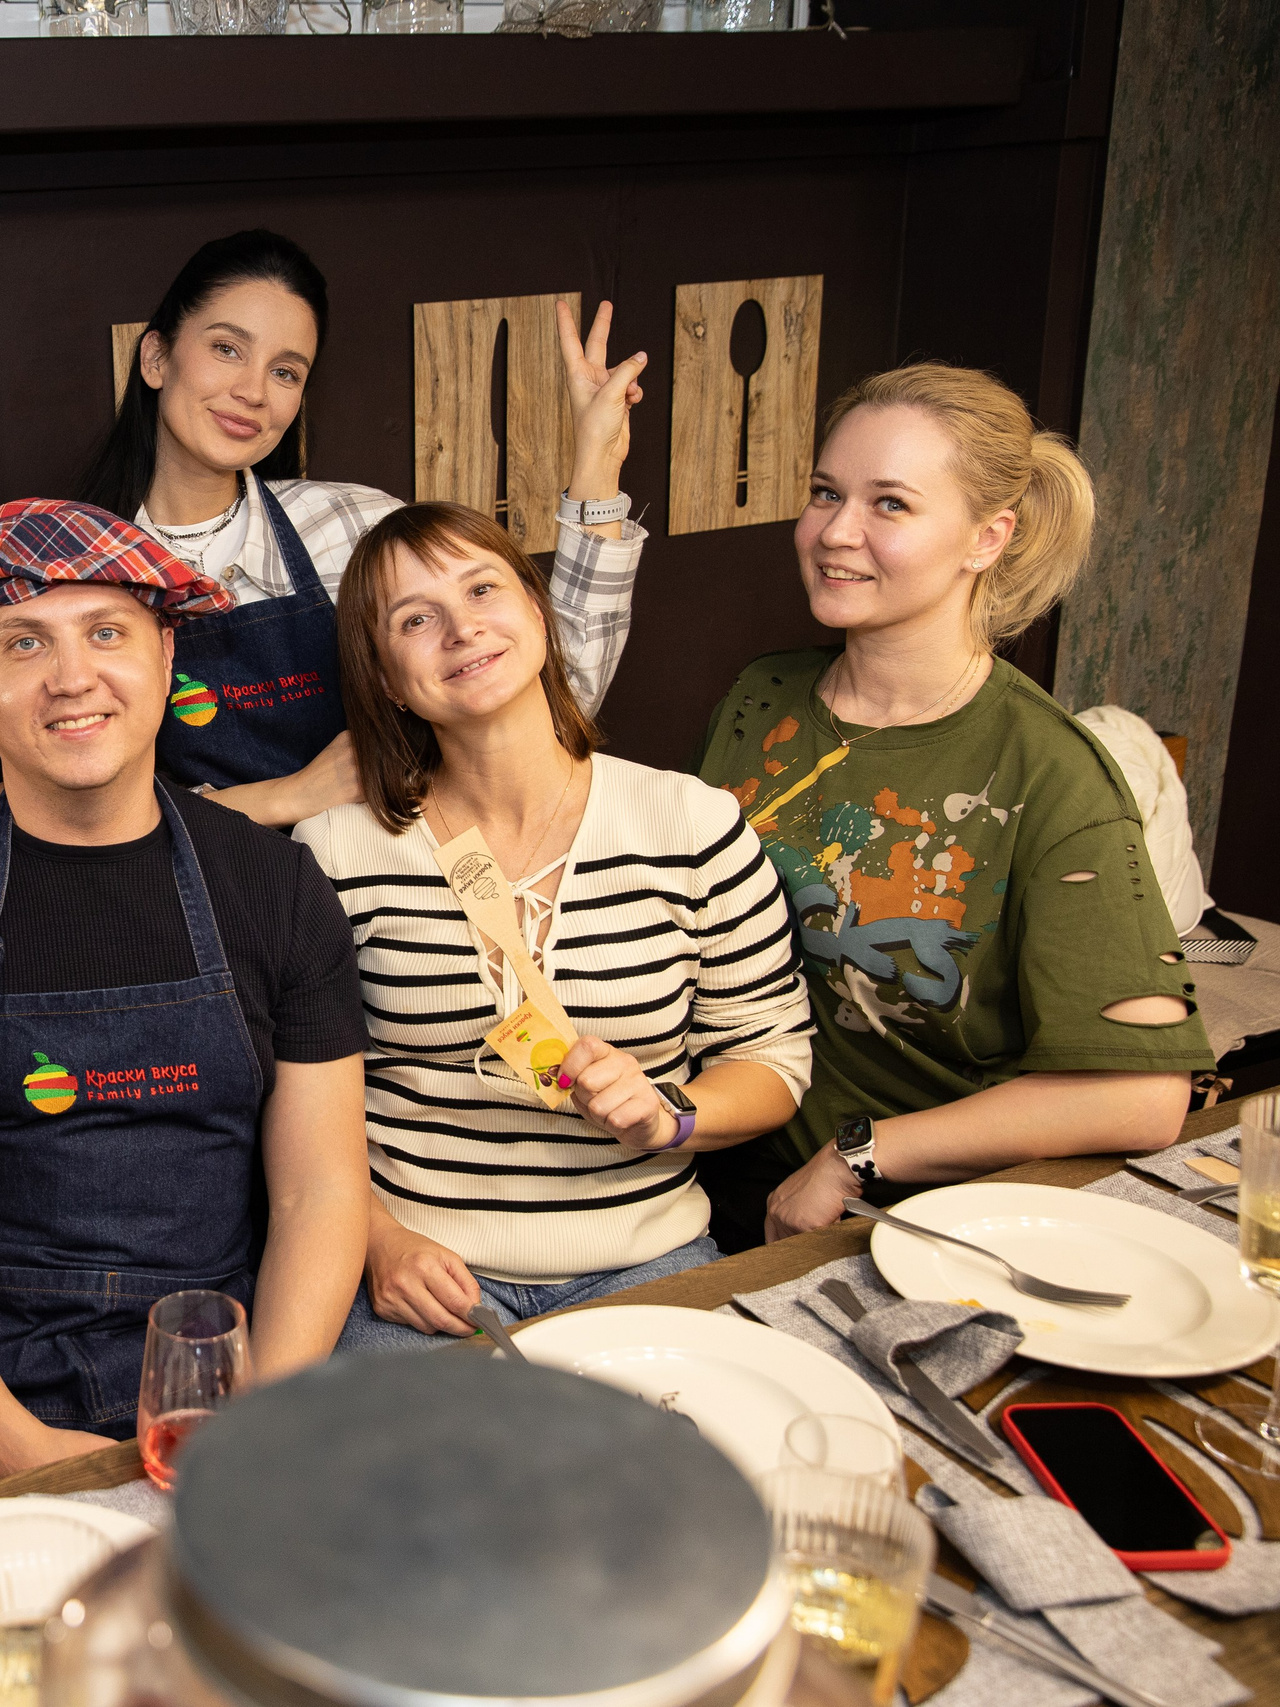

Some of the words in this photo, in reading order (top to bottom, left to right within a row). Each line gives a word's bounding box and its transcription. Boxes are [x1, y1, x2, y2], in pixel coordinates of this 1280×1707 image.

[222, 680, 276, 702] Краски
[277, 671, 320, 689] вкуса
[280, 686, 326, 702] studio
[473, 861, 493, 880] Краски
[85, 1068, 147, 1091] Краски
[150, 1063, 199, 1083] вкуса
[87, 1086, 142, 1101] Family
[150, 1081, 200, 1096] studio
